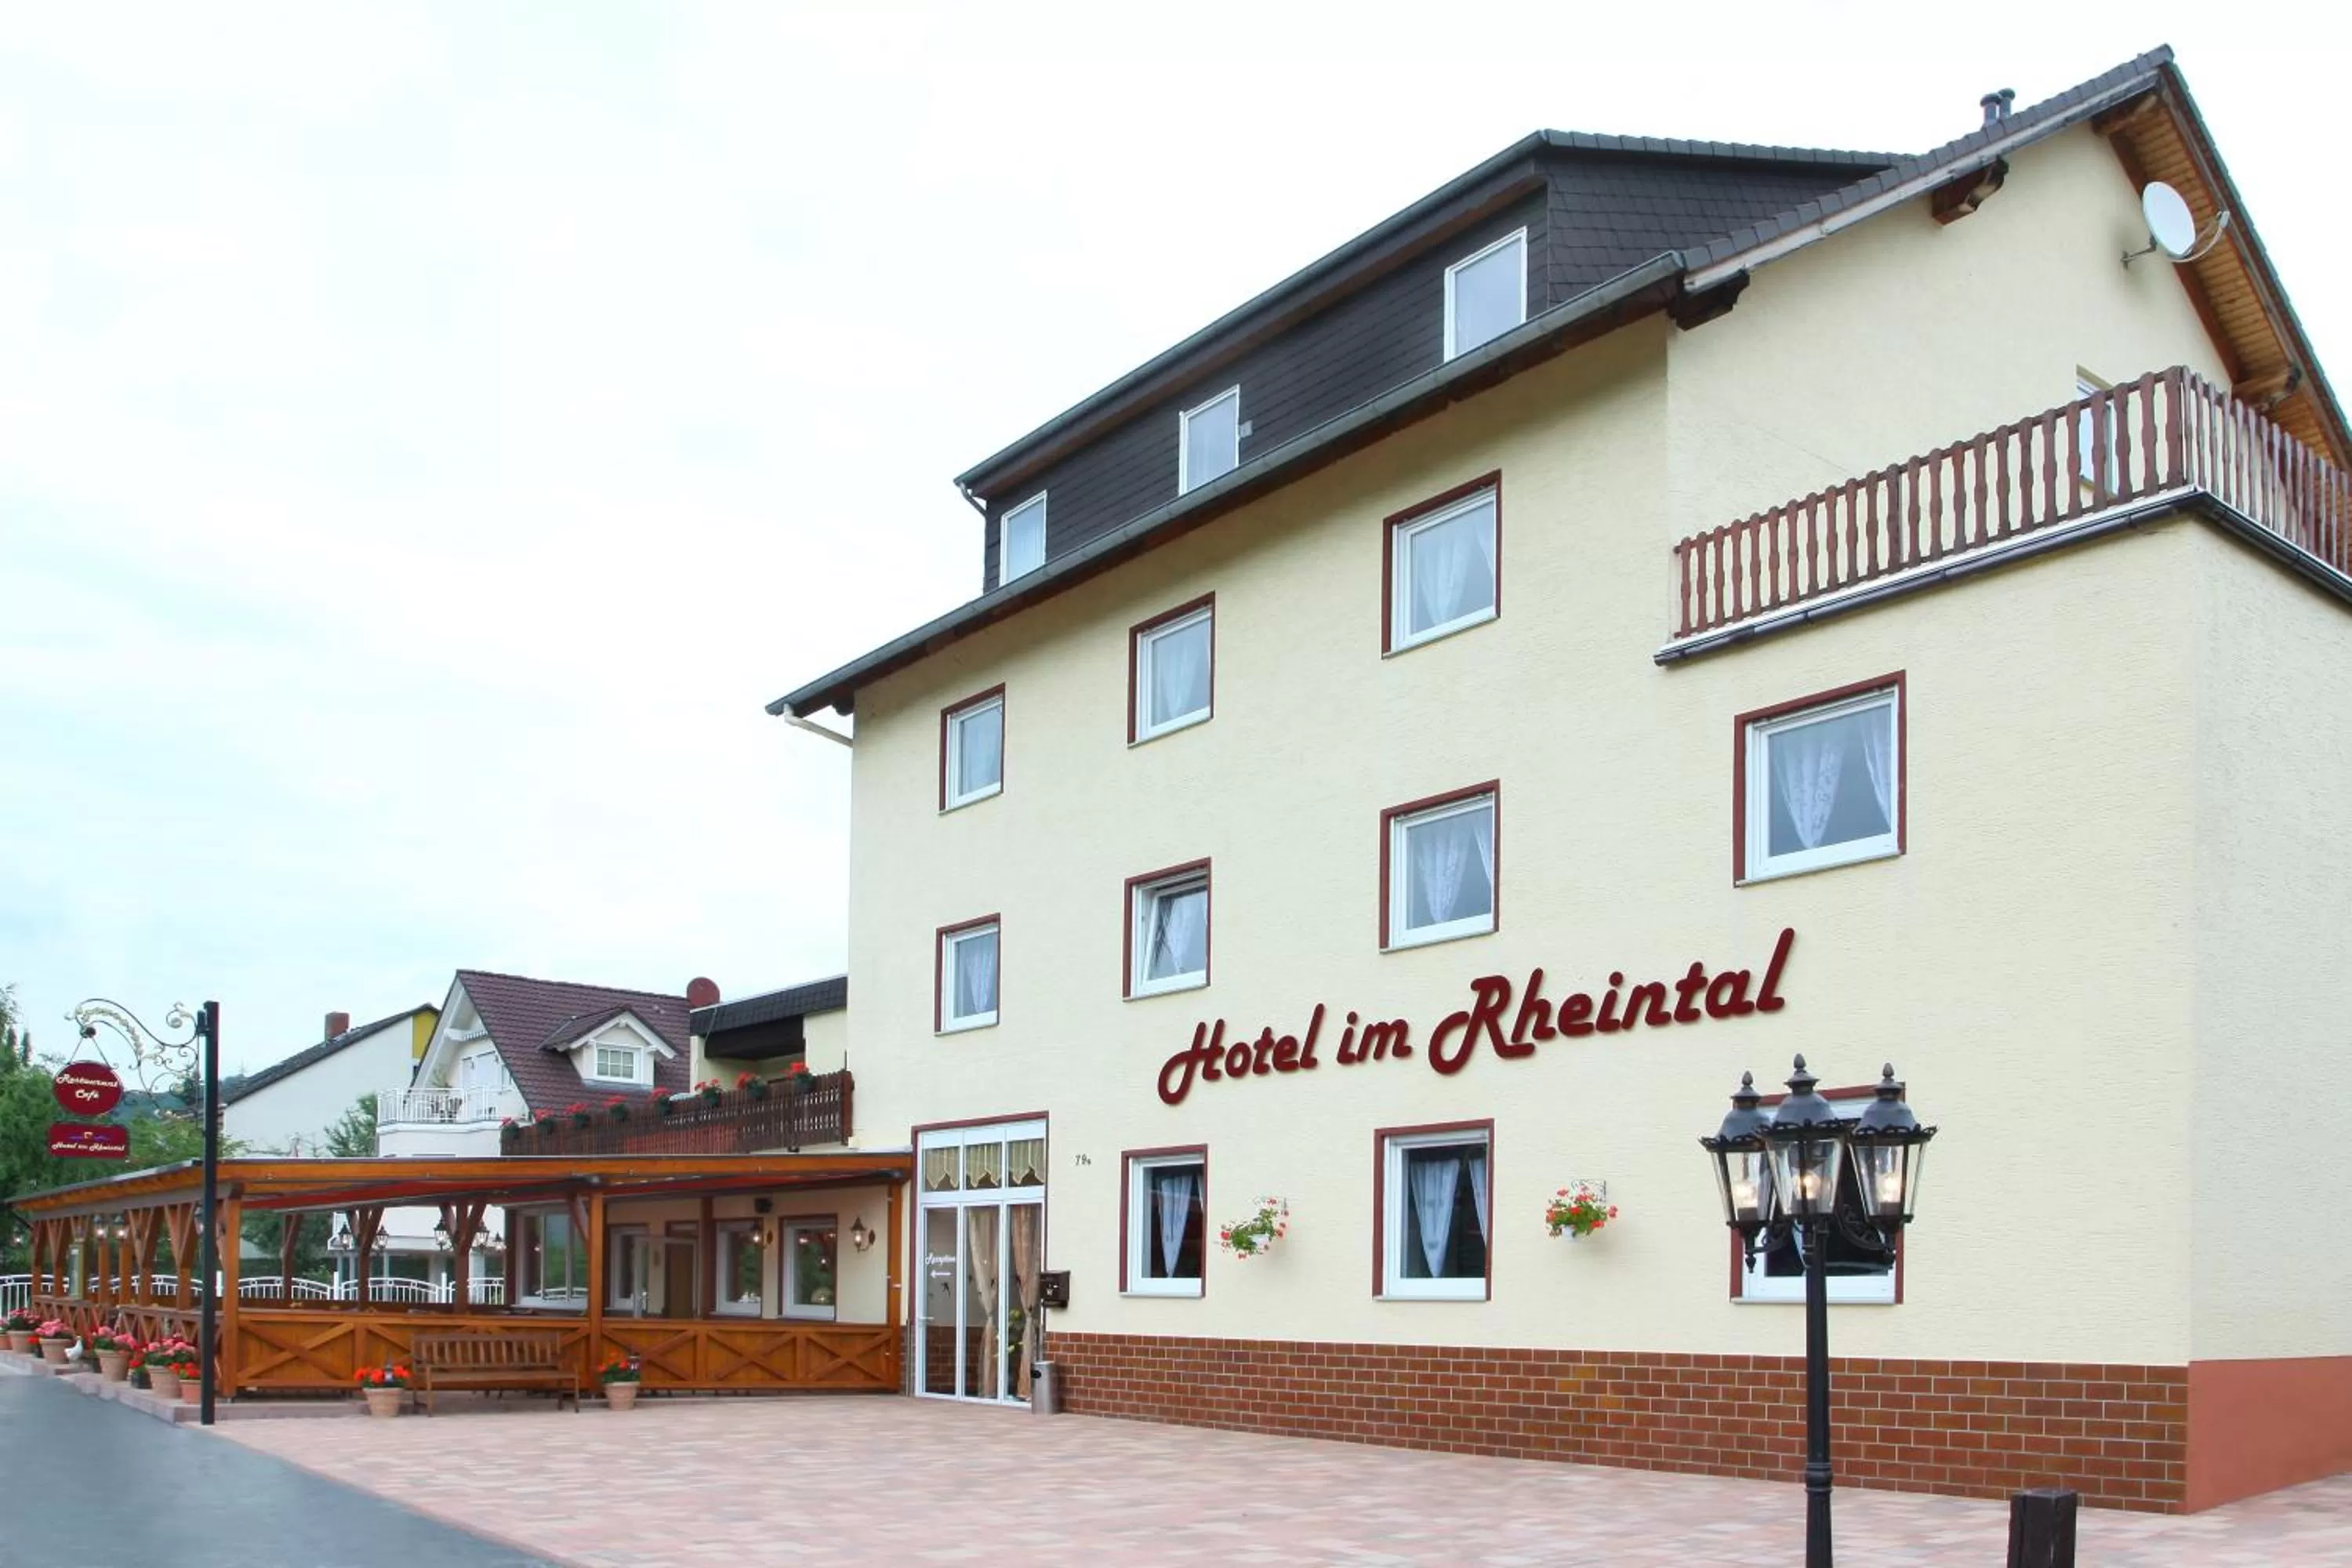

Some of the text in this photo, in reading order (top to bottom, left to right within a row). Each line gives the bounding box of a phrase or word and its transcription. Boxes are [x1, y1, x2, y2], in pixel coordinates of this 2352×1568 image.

[1159, 927, 1794, 1105] Hotel im Rheintal
[56, 1073, 118, 1087] Restaurant
